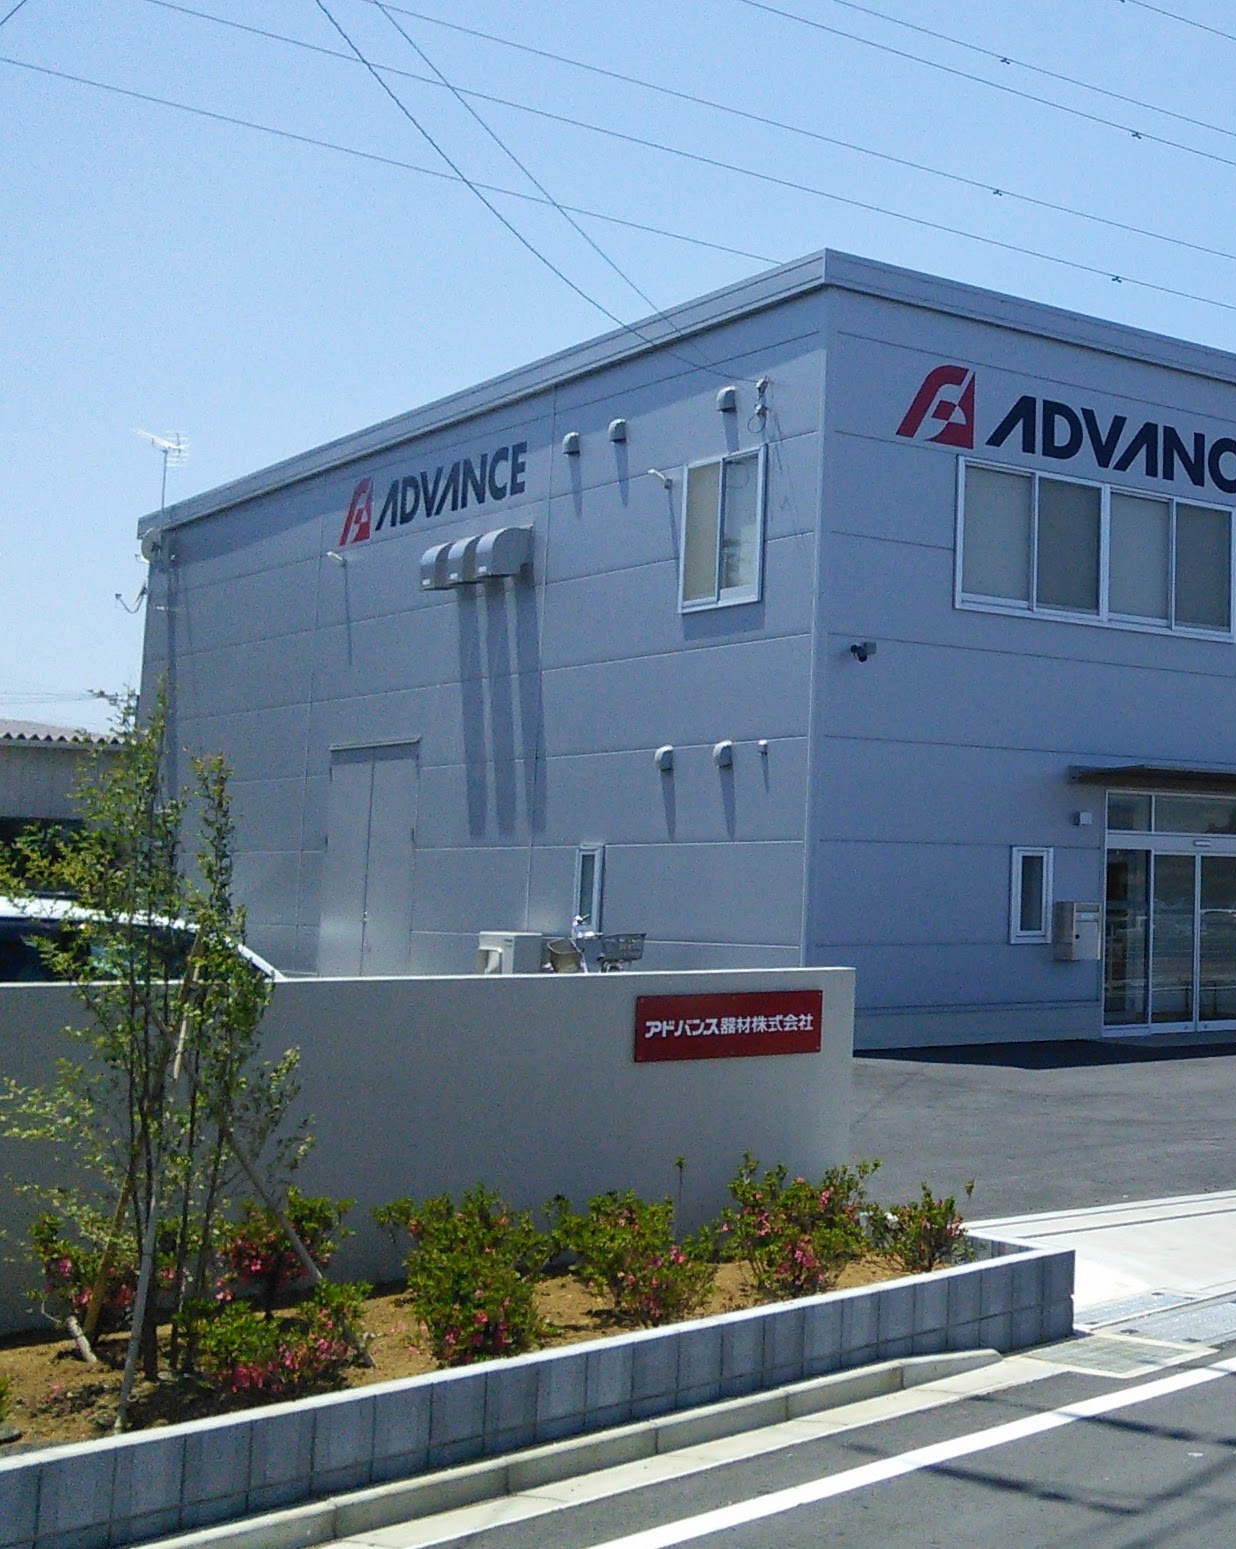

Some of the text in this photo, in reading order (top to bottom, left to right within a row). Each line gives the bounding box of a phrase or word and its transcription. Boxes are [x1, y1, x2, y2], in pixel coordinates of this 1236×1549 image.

[375, 441, 528, 531] ADVANCE
[644, 1013, 814, 1039] アドバンス器材株式会社
